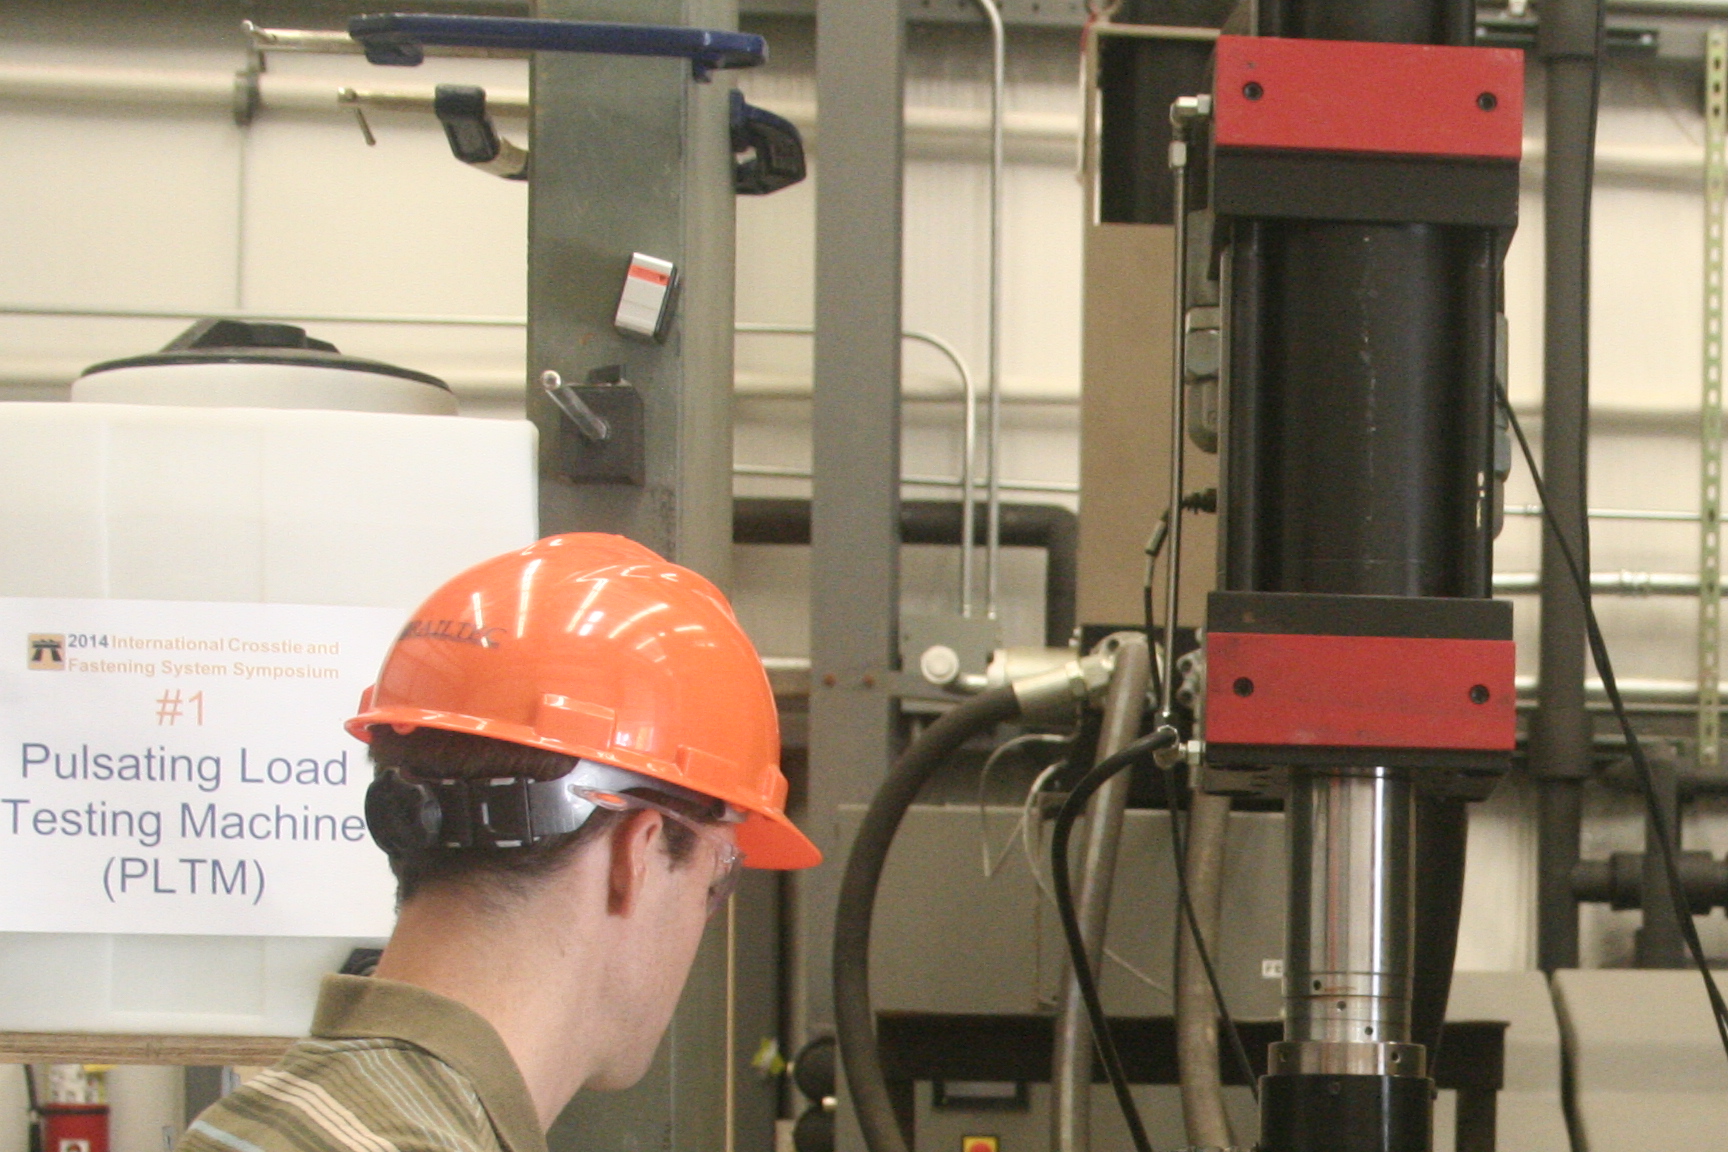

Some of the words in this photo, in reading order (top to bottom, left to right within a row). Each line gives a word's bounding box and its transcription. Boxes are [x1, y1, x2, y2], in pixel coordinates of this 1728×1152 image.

[68, 634, 109, 648] 2014
[112, 635, 225, 652] International
[228, 638, 302, 654] Crosstie
[306, 641, 340, 656] and
[68, 658, 156, 677] Fastening
[161, 660, 227, 677] System
[233, 661, 340, 680] Symposium
[156, 688, 204, 726] #1
[21, 742, 222, 792] Pulsating
[240, 747, 348, 785] Load
[1, 798, 162, 847] Testing
[180, 802, 367, 842] Machine
[102, 856, 266, 905] (PLTM)
